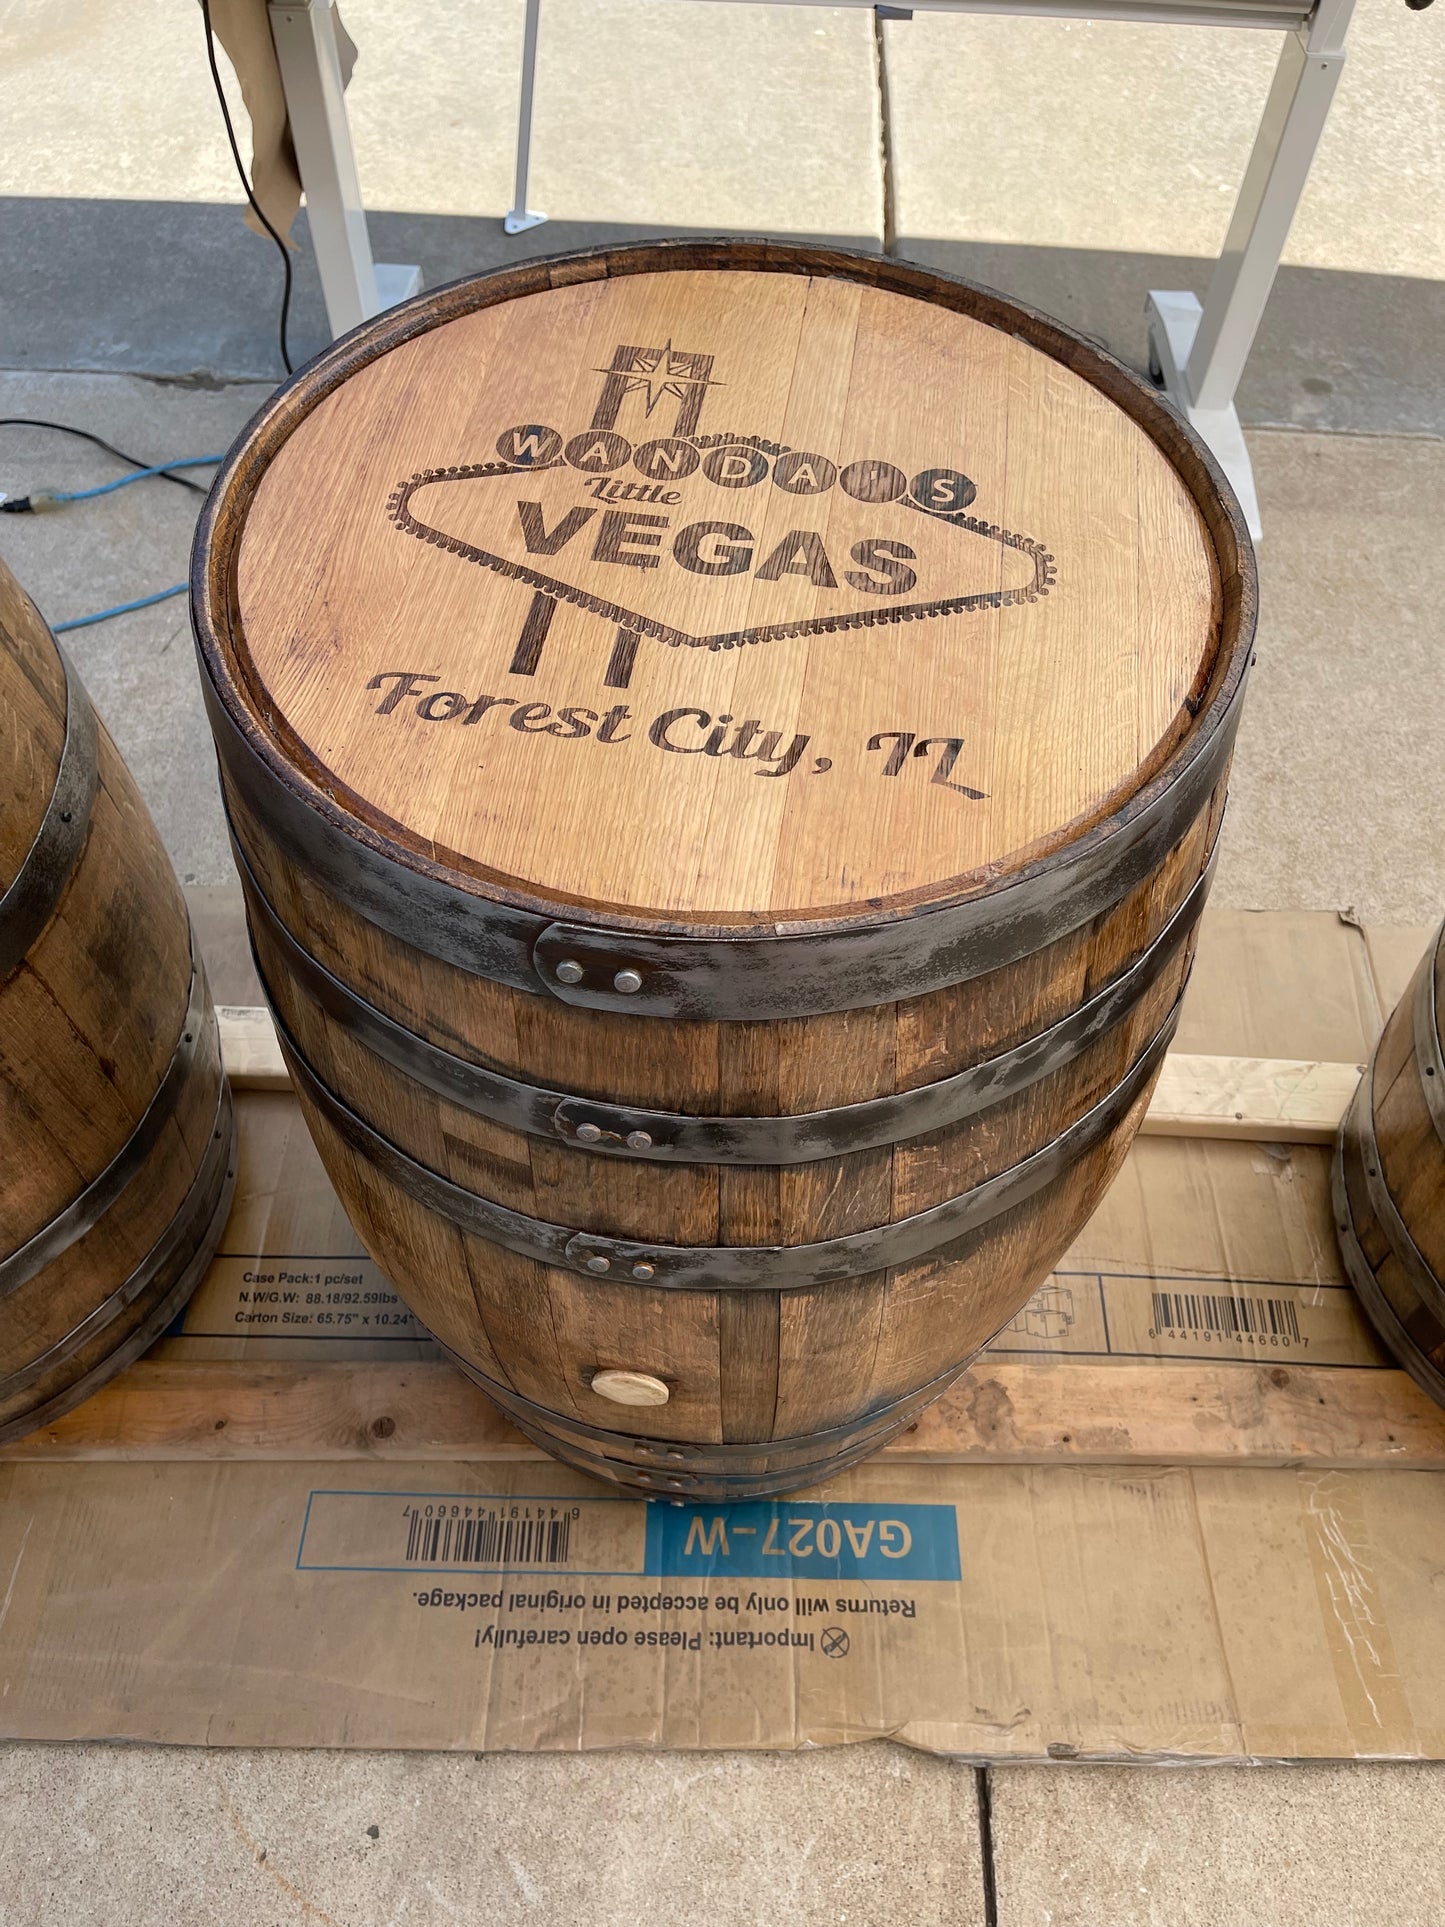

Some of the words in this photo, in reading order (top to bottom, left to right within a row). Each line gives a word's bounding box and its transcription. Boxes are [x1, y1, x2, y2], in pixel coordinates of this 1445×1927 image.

[508, 430, 957, 503] WANDA'S
[583, 476, 682, 506] Little
[516, 500, 918, 596] VEGAS
[365, 670, 633, 745] Forest
[647, 706, 834, 779] City,
[866, 731, 991, 801] IL
[242, 1271, 275, 1285] Case
[324, 1272, 364, 1287] pc/set
[238, 1291, 300, 1304] N.W/G.W:
[234, 1311, 278, 1324] Carton
[281, 1312, 313, 1324] Size:
[361, 1315, 370, 1325] x
[683, 1515, 913, 1559] GA027-W
[413, 1588, 503, 1611] package.
[508, 1590, 586, 1613] original
[593, 1594, 611, 1613] in
[617, 1592, 709, 1613] accepted
[715, 1595, 739, 1614] be
[745, 1592, 790, 1615] only
[795, 1597, 830, 1616] will
[835, 1598, 917, 1618] Returns
[475, 1624, 571, 1649] carefully!
[576, 1626, 628, 1645] open
[633, 1629, 702, 1650] Please
[709, 1627, 815, 1651] Important:
